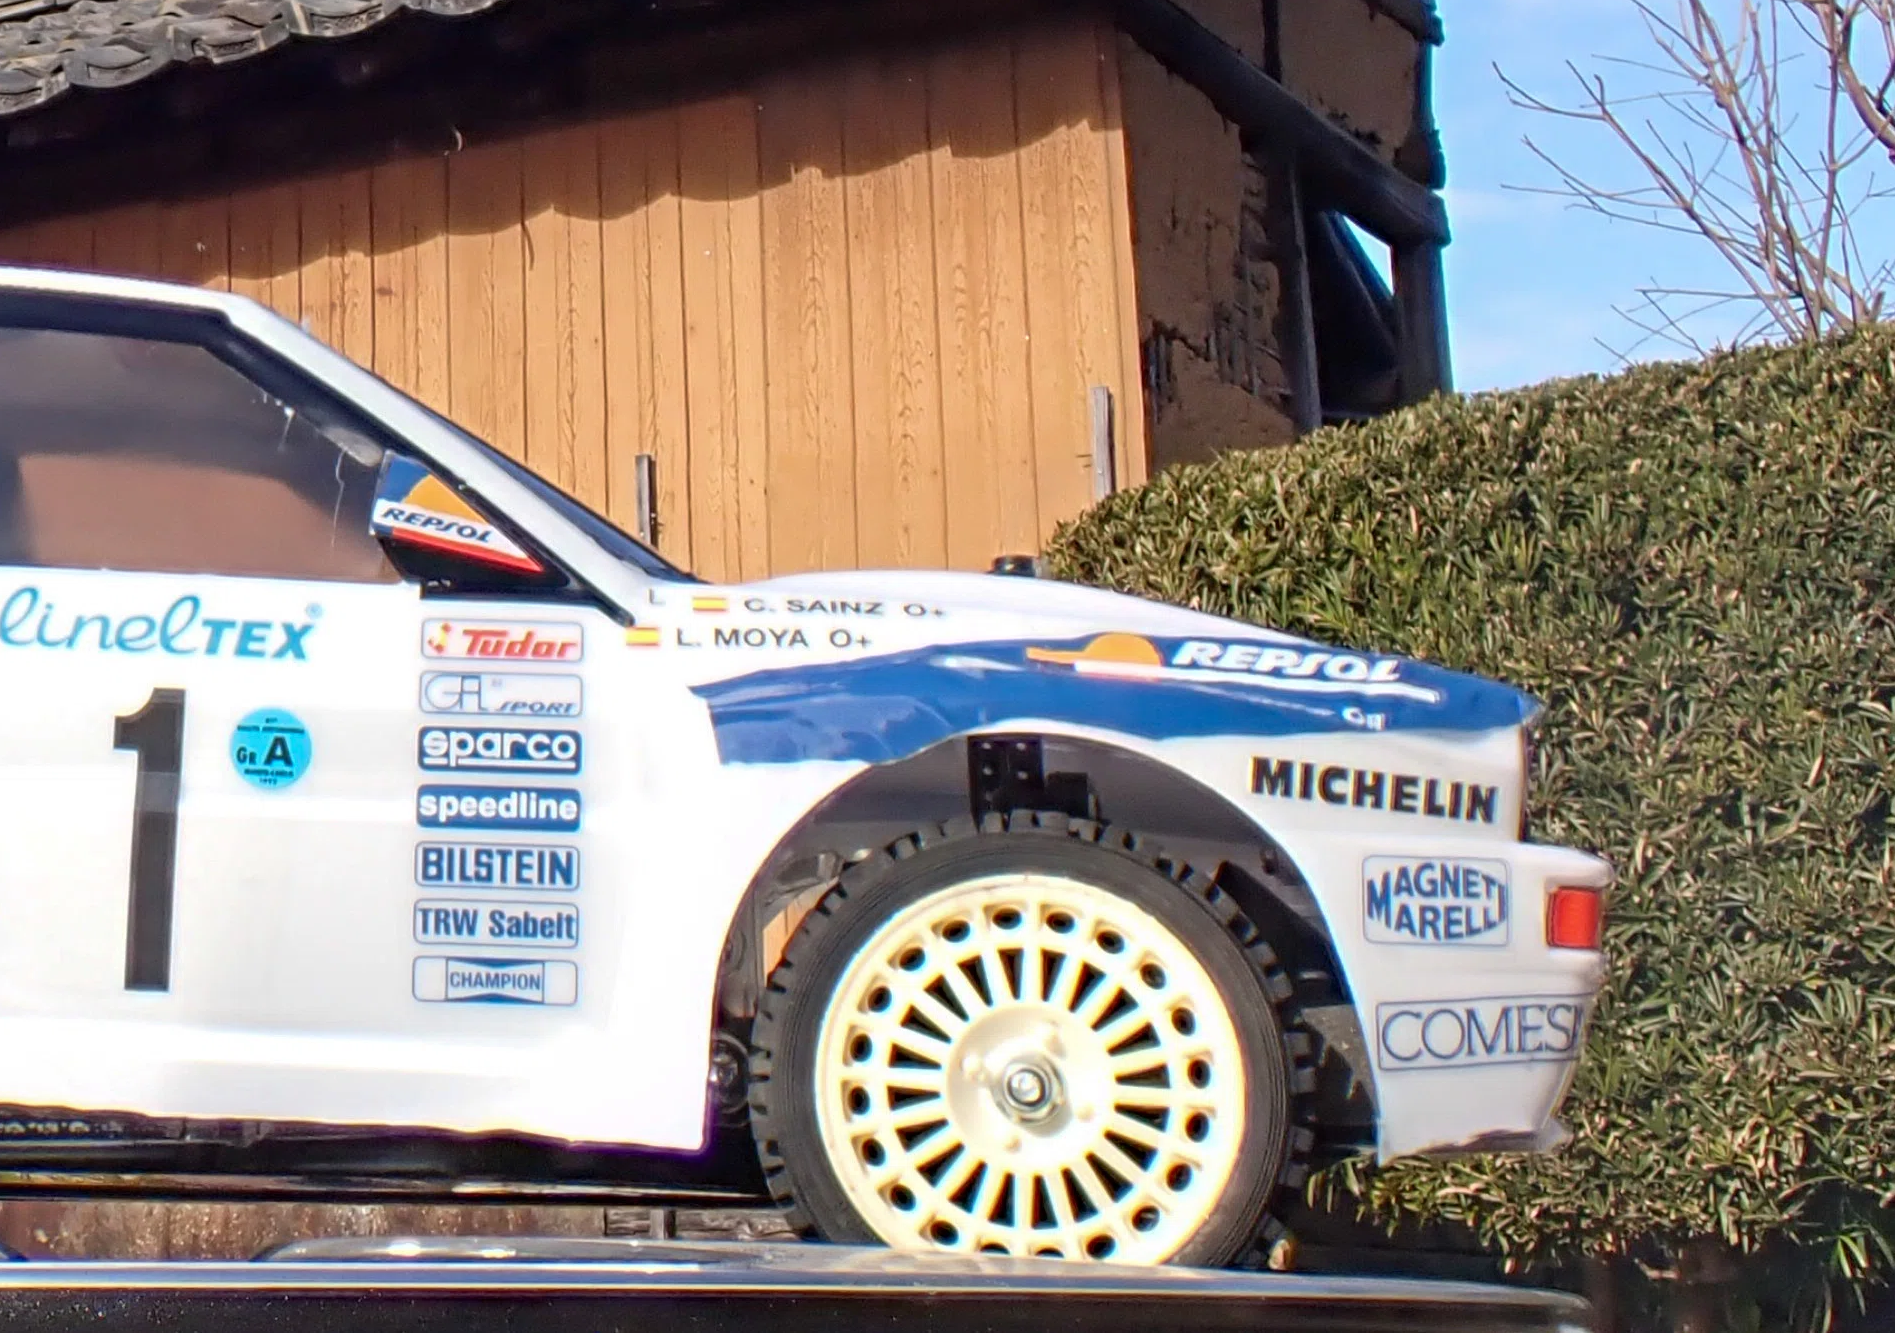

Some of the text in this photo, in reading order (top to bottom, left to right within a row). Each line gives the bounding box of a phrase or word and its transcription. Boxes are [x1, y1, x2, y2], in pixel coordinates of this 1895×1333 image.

[381, 507, 494, 543] REPSOL
[743, 597, 777, 612] C.
[786, 598, 885, 616] SAINZ
[462, 628, 578, 658] Tudor
[676, 627, 703, 647] L.
[713, 627, 810, 648] MOYA
[1172, 640, 1402, 682] REPSOL
[263, 735, 294, 767] A
[423, 730, 577, 767] sparco
[1250, 755, 1500, 824] MICHELIN
[418, 790, 578, 823] speedline
[114, 688, 187, 993] 1
[421, 846, 574, 886] BILSTEIN
[418, 907, 575, 940] TRW Sabelt
[449, 970, 542, 990] CHAMPION
